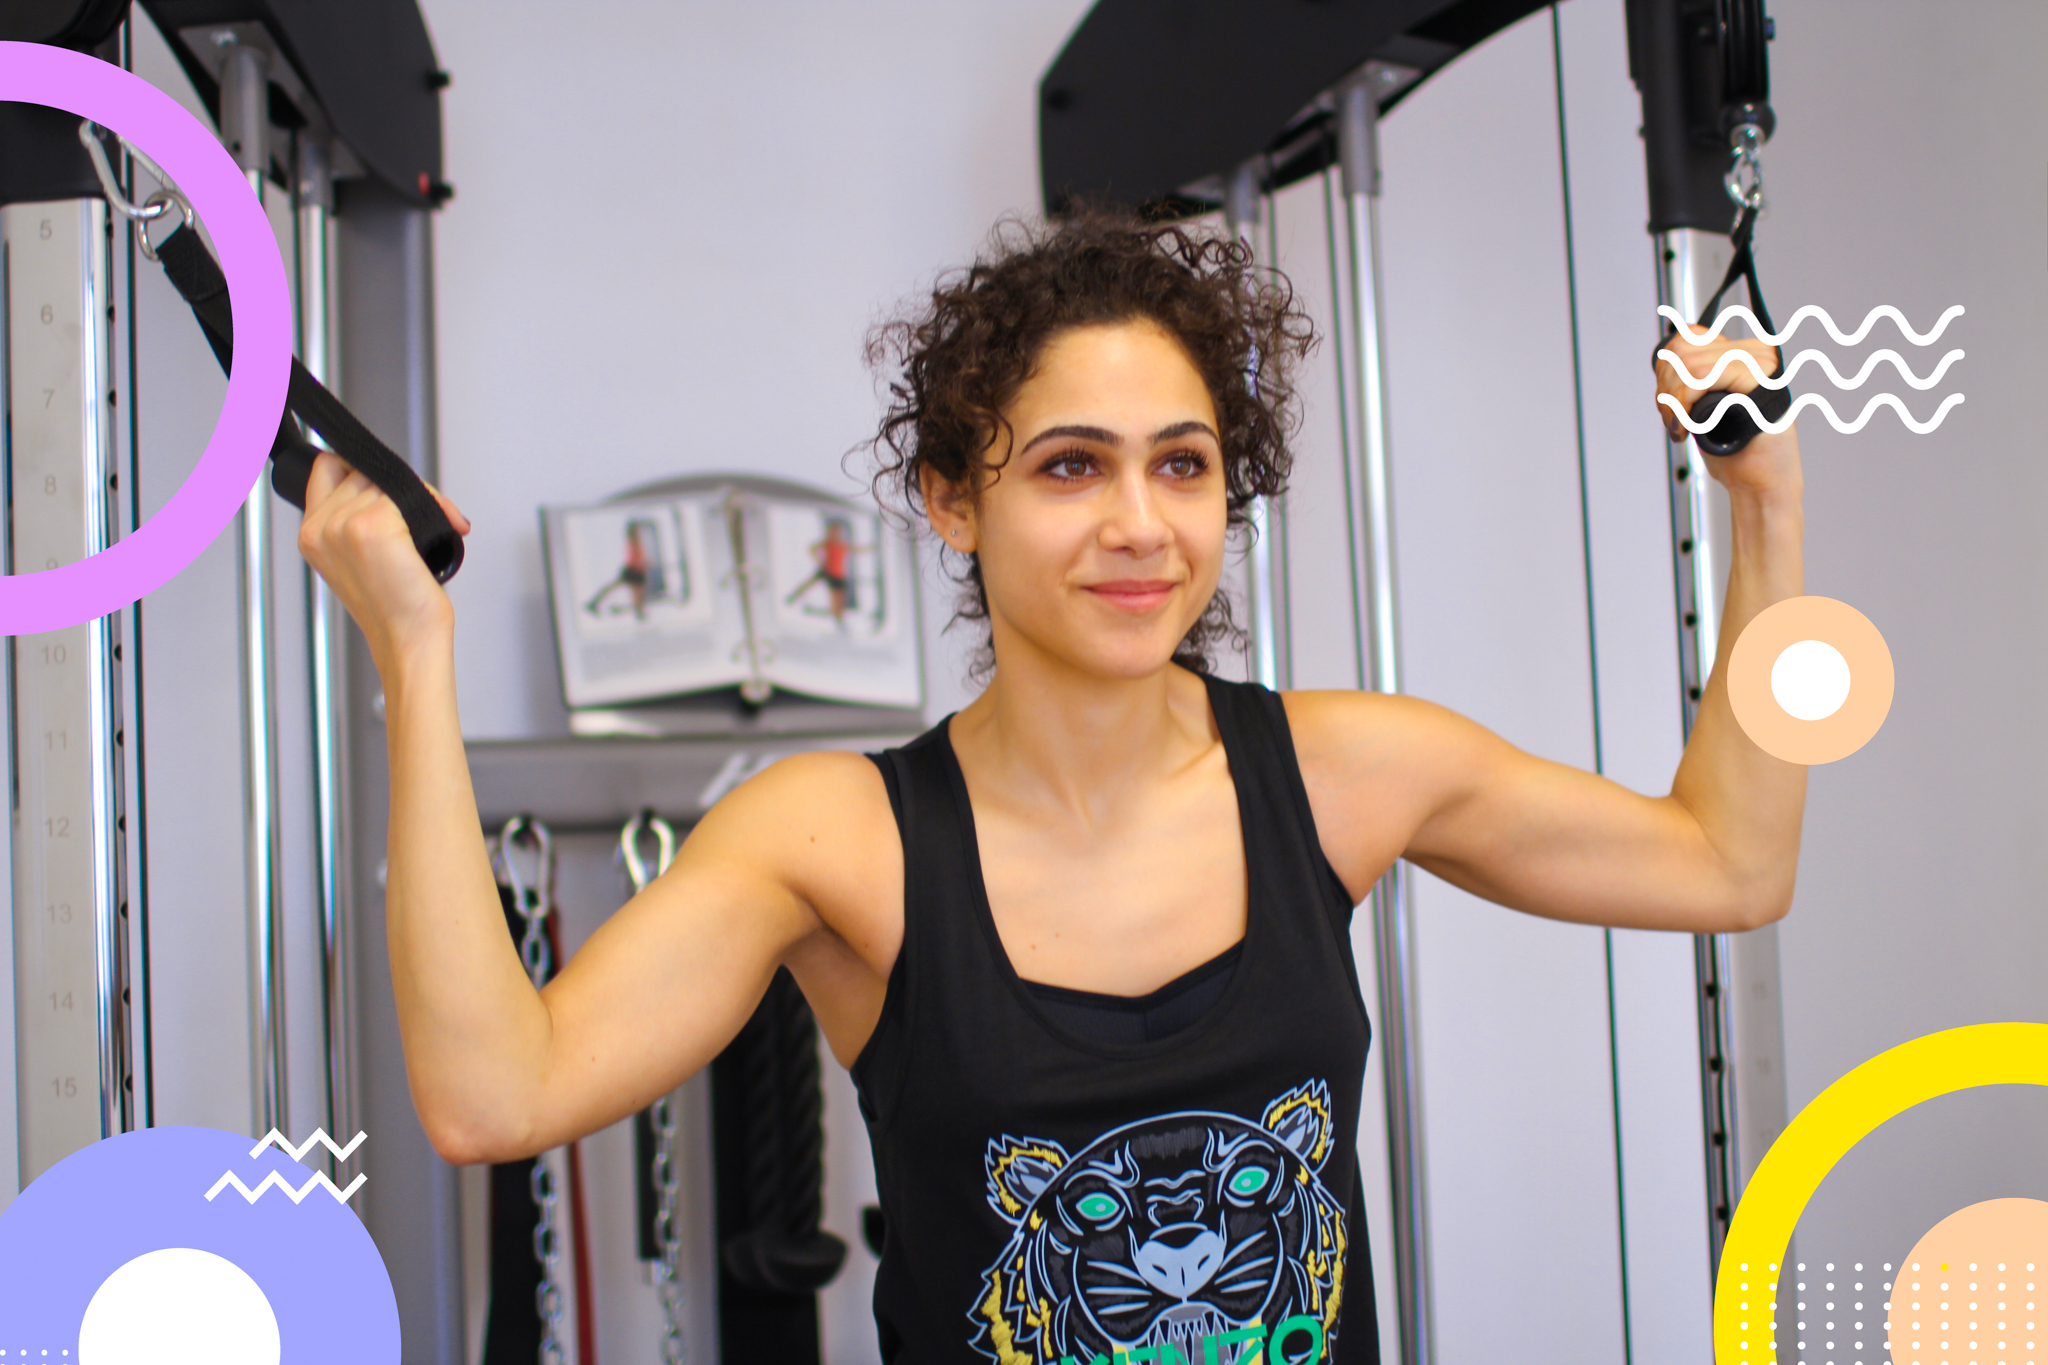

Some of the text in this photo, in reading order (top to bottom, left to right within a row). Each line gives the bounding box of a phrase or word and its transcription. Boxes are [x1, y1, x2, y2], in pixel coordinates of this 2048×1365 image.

[39, 219, 53, 240] 5
[40, 304, 54, 324] 6
[43, 388, 56, 409] 7
[44, 474, 57, 495] 8
[41, 644, 67, 665] 10
[44, 730, 67, 751] 11
[45, 817, 70, 838] 12
[47, 903, 73, 923] 13
[49, 991, 74, 1011] 14
[52, 1077, 78, 1097] 15
